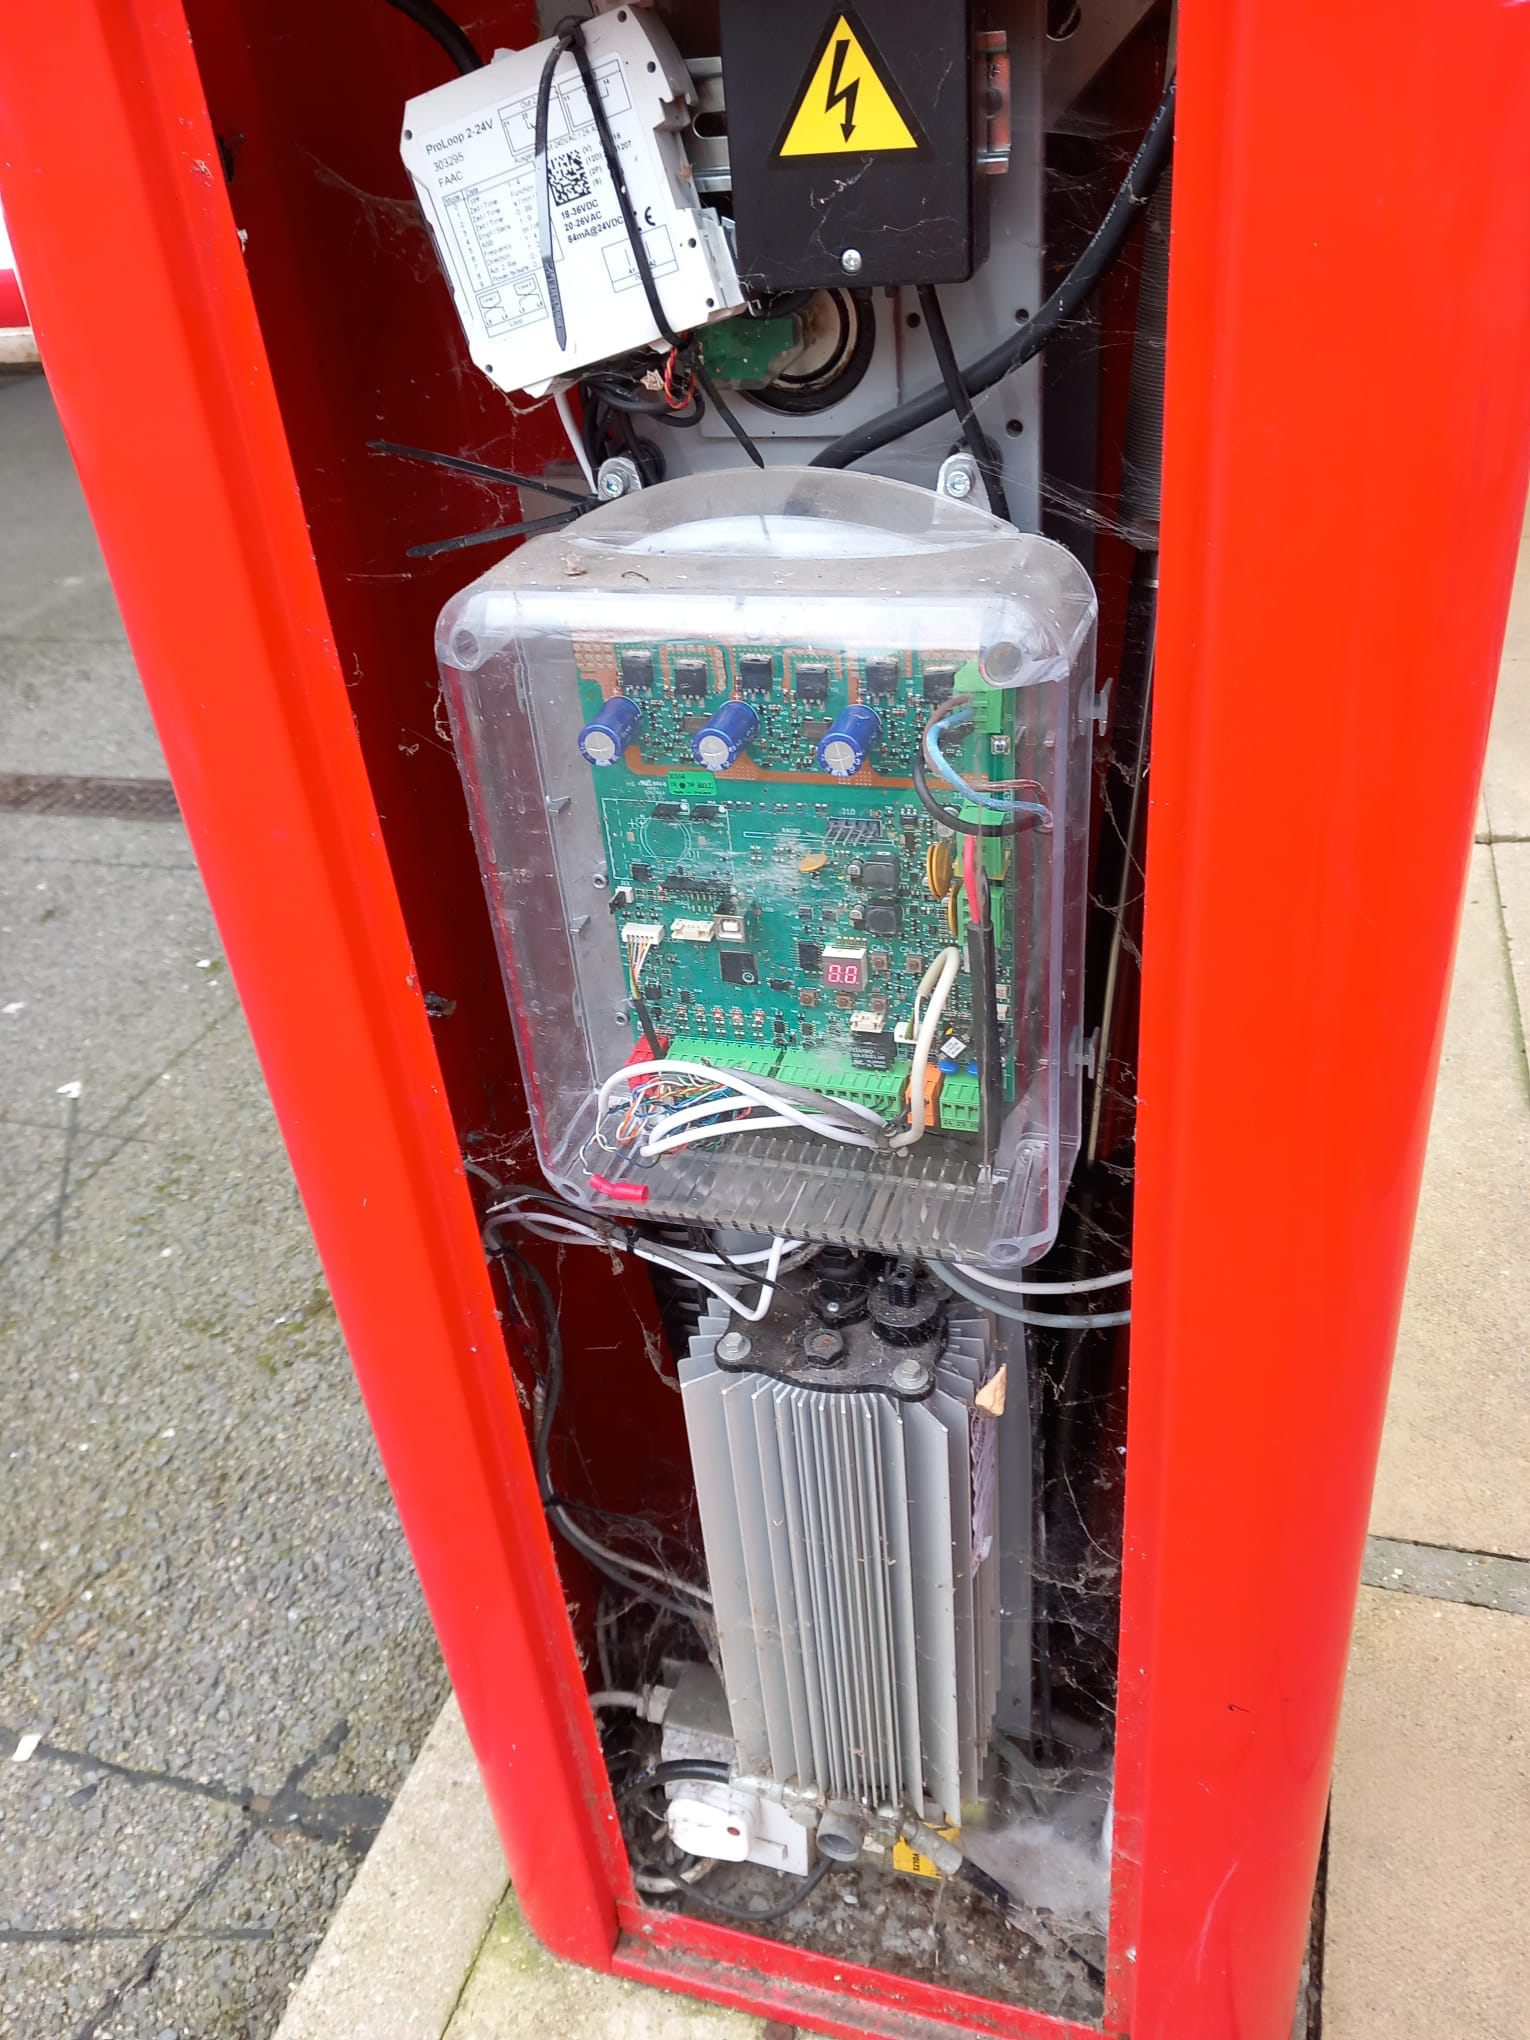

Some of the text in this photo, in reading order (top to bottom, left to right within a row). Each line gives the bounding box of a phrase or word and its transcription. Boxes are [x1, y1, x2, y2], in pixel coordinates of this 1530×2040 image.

[425, 118, 492, 155] ProLoop 2-24V
[433, 151, 464, 172] 303295
[438, 170, 463, 187] FAAC
[1090, 204, 1117, 247] KWANG
